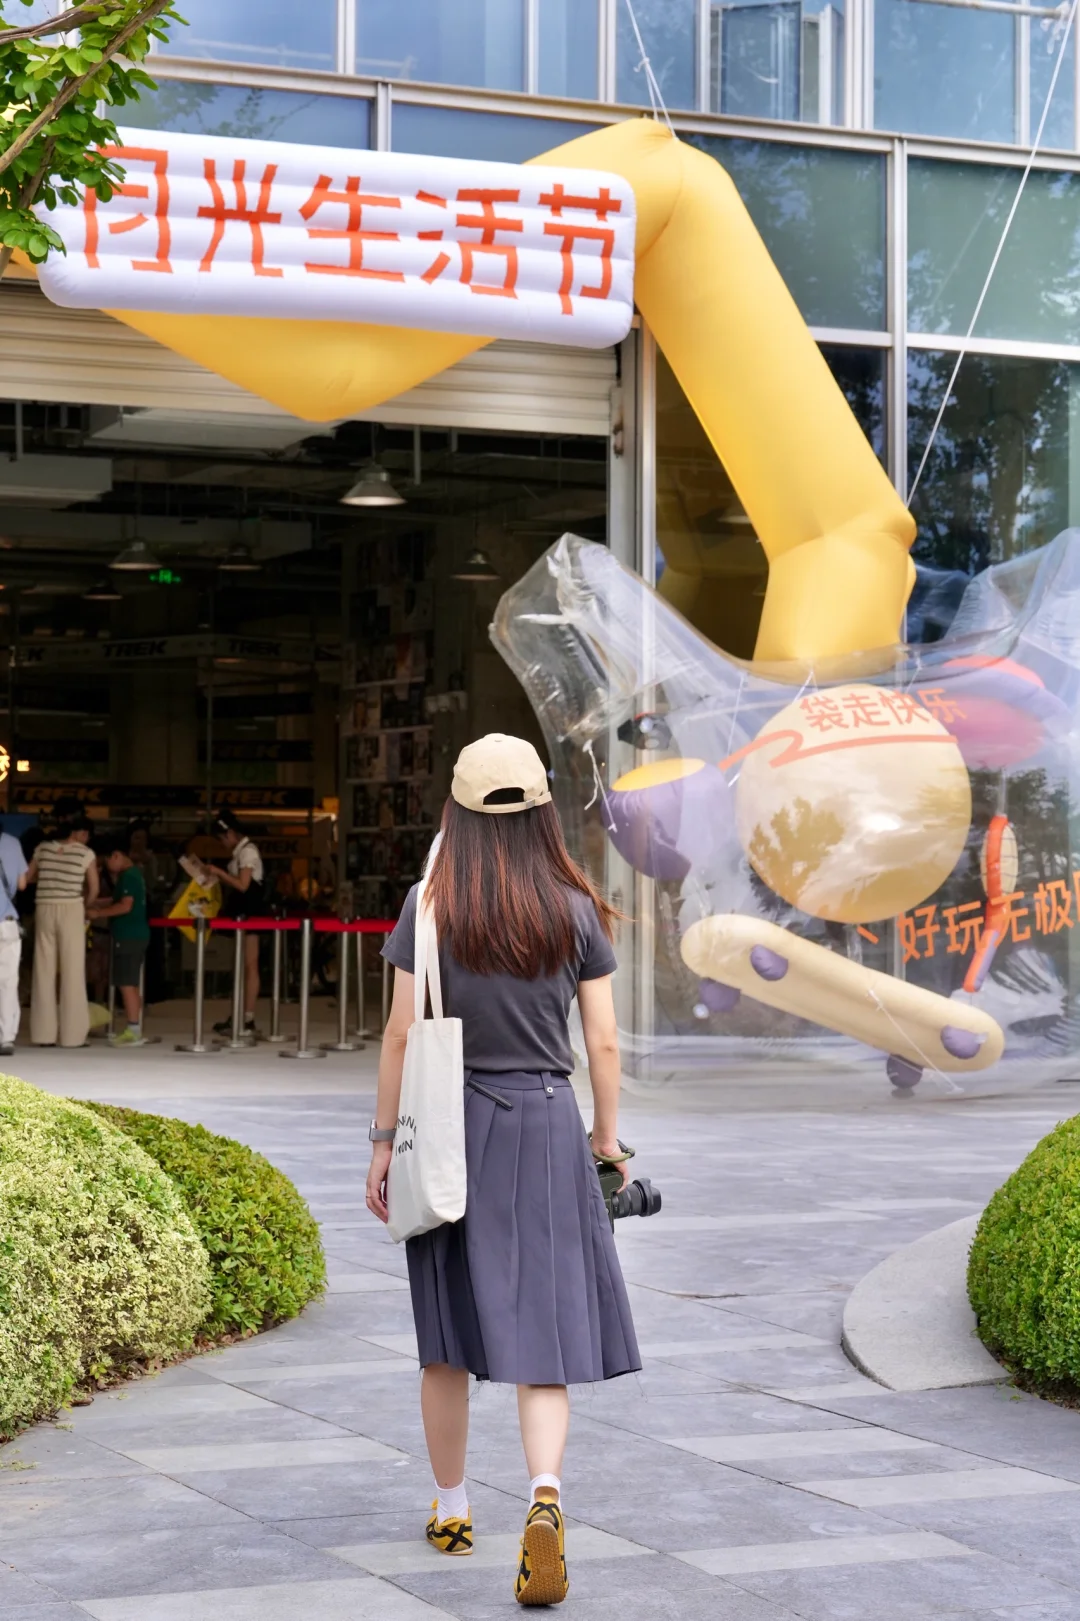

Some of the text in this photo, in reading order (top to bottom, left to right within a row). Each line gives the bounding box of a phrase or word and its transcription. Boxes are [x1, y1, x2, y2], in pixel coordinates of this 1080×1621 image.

[102, 640, 167, 657] TREK
[799, 688, 967, 731] 袋走快乐
[896, 870, 1080, 964] 好玩无极
